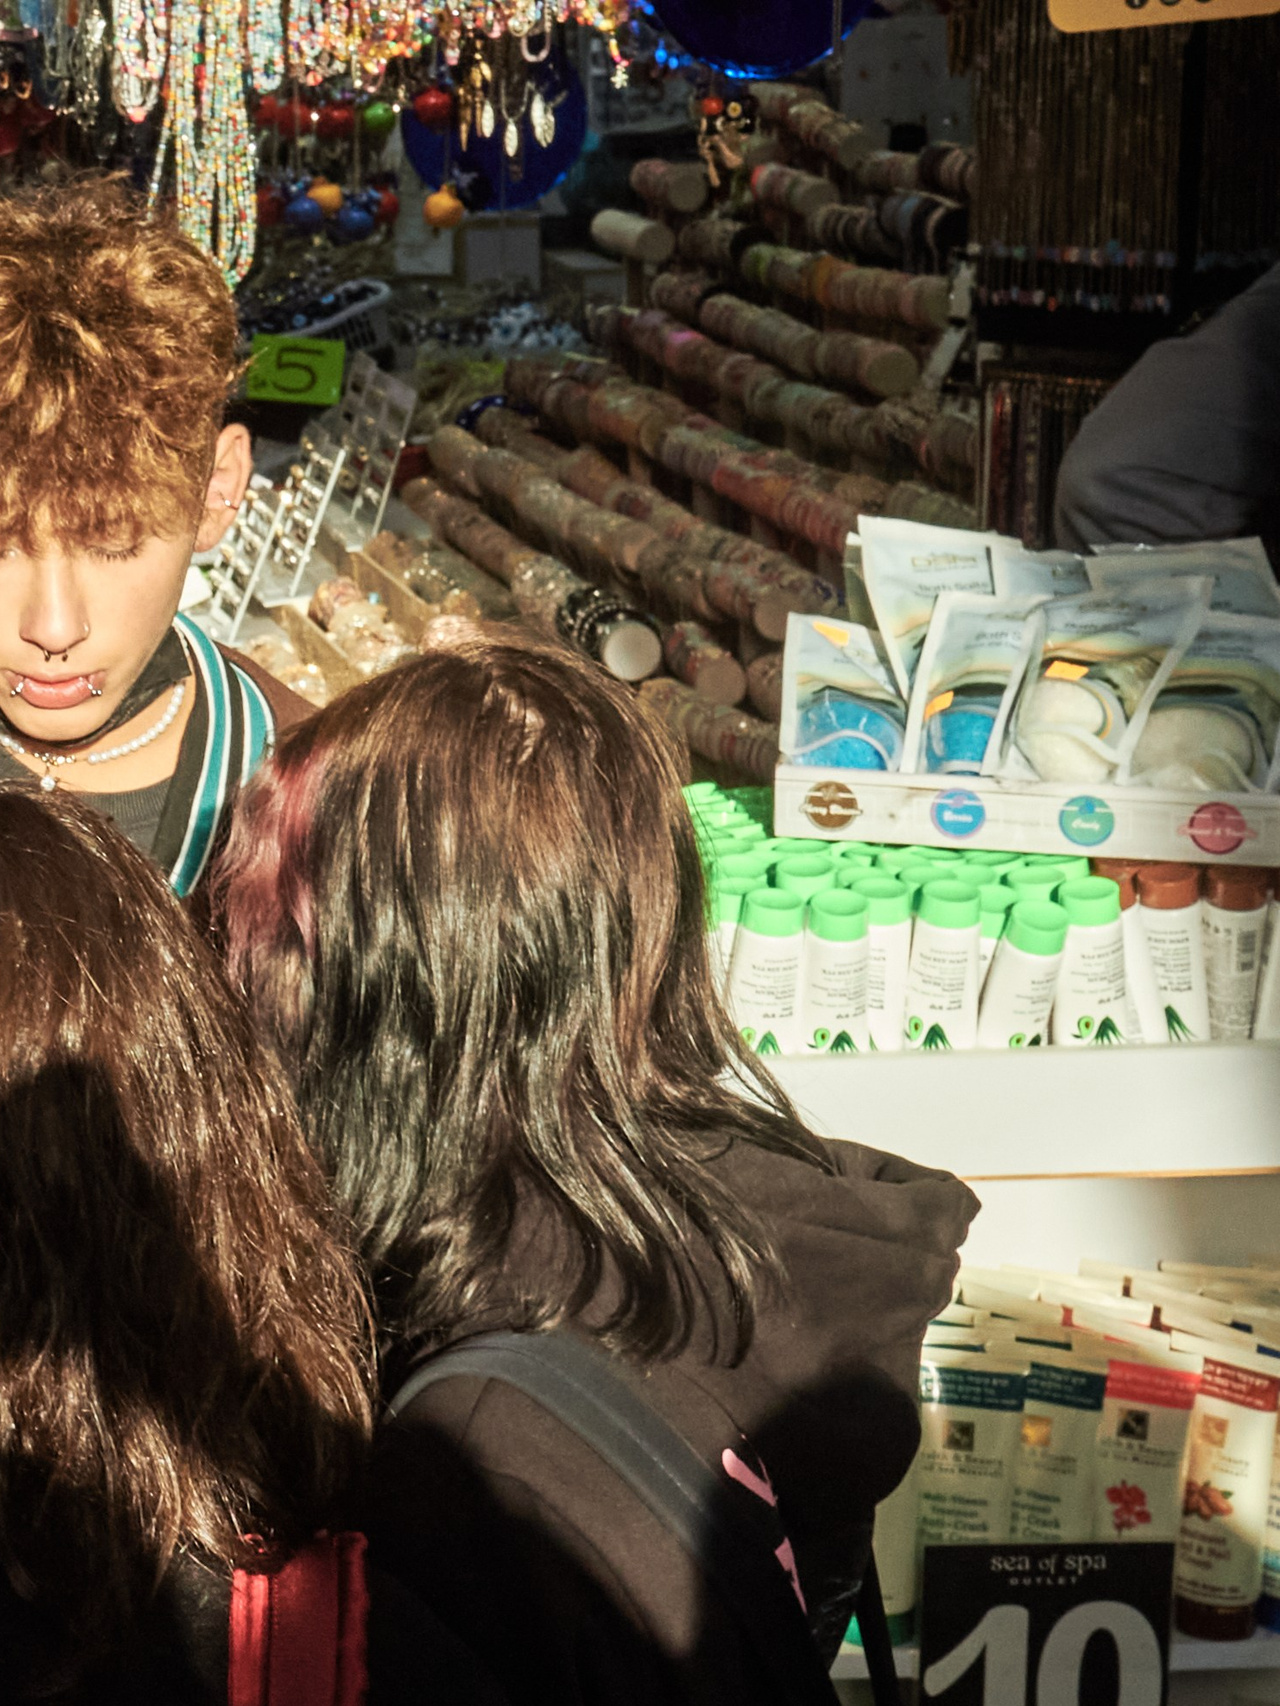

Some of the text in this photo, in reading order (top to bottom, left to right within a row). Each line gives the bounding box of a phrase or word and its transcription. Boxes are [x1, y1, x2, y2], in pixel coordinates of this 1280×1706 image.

[272, 346, 324, 394] 5
[990, 1554, 1108, 1576] sea of spa
[1009, 1576, 1079, 1586] OUTLET
[923, 1600, 1163, 1706] 10
